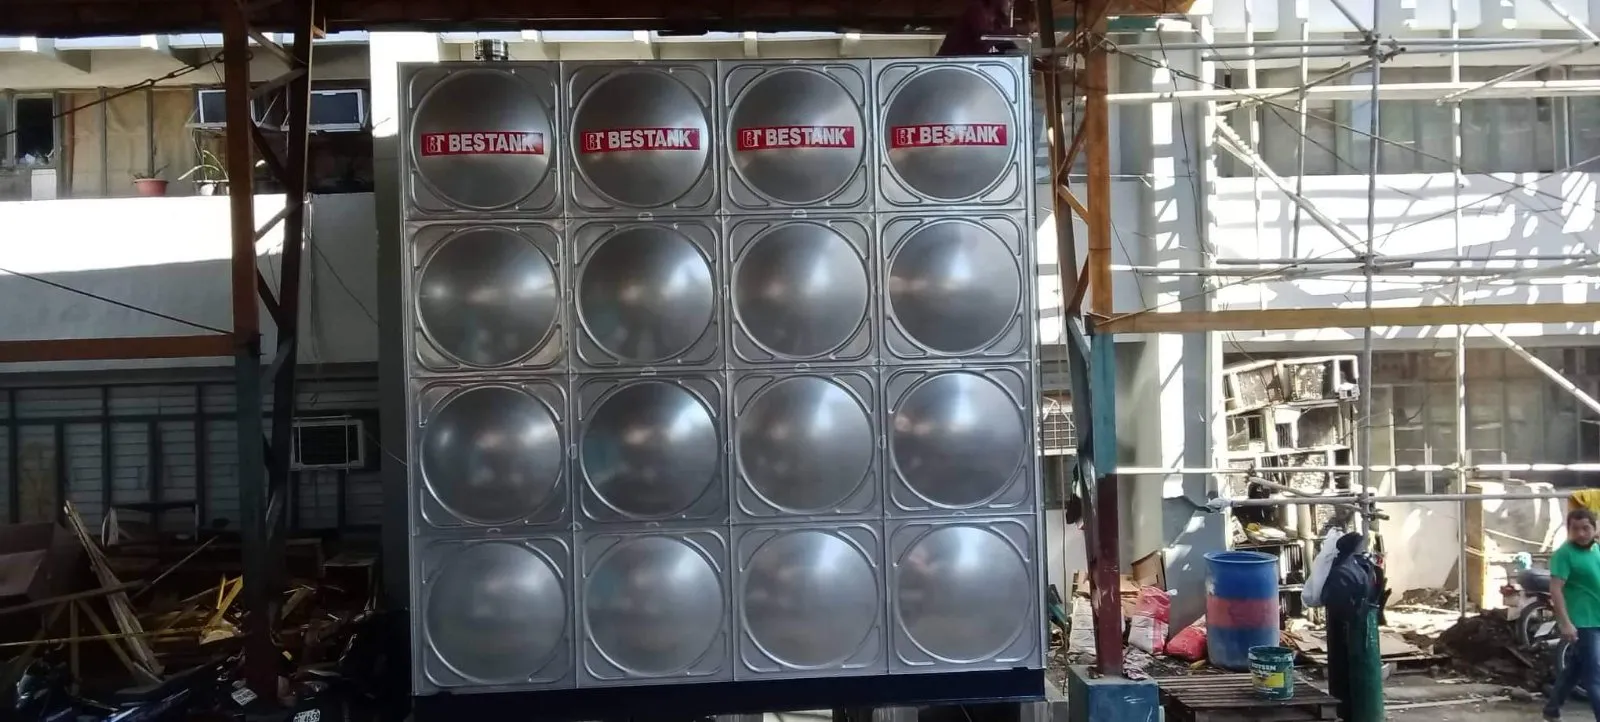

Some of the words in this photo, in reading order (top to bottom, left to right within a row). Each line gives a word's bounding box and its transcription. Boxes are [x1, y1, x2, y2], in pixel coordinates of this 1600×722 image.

[448, 133, 536, 152] BESTANK
[608, 130, 692, 149] BESTANK
[765, 127, 846, 146] BESTANK
[919, 125, 1000, 144] BESTANK
